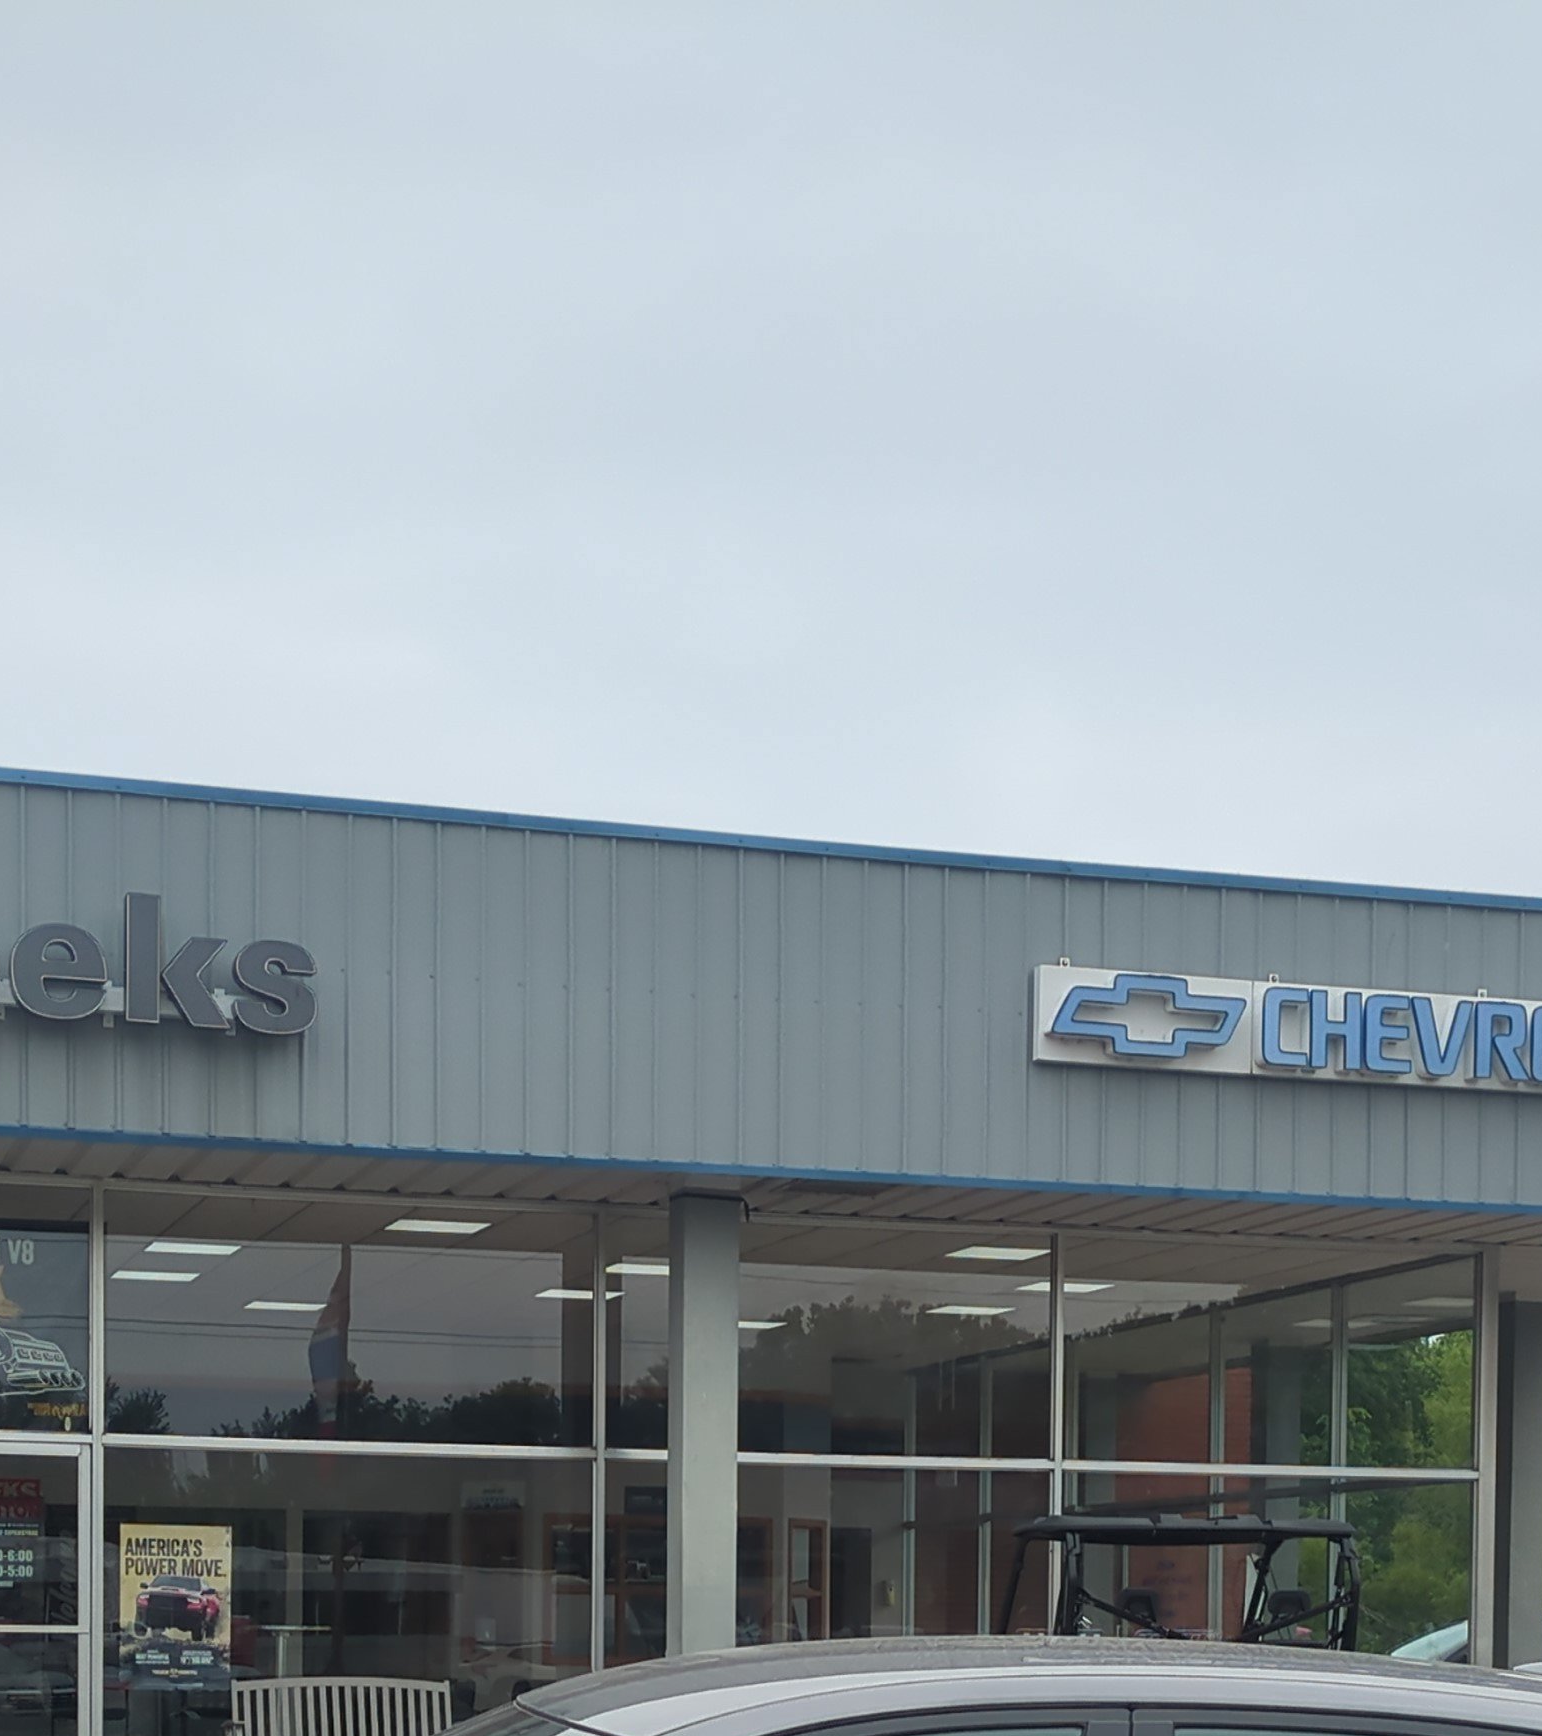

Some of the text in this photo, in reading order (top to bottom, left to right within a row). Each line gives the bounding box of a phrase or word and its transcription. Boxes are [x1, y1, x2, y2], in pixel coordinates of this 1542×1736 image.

[8, 1239, 35, 1265] V8
[125, 1537, 203, 1558] AMERICA'S
[125, 1557, 227, 1578] POWER MOVE.
